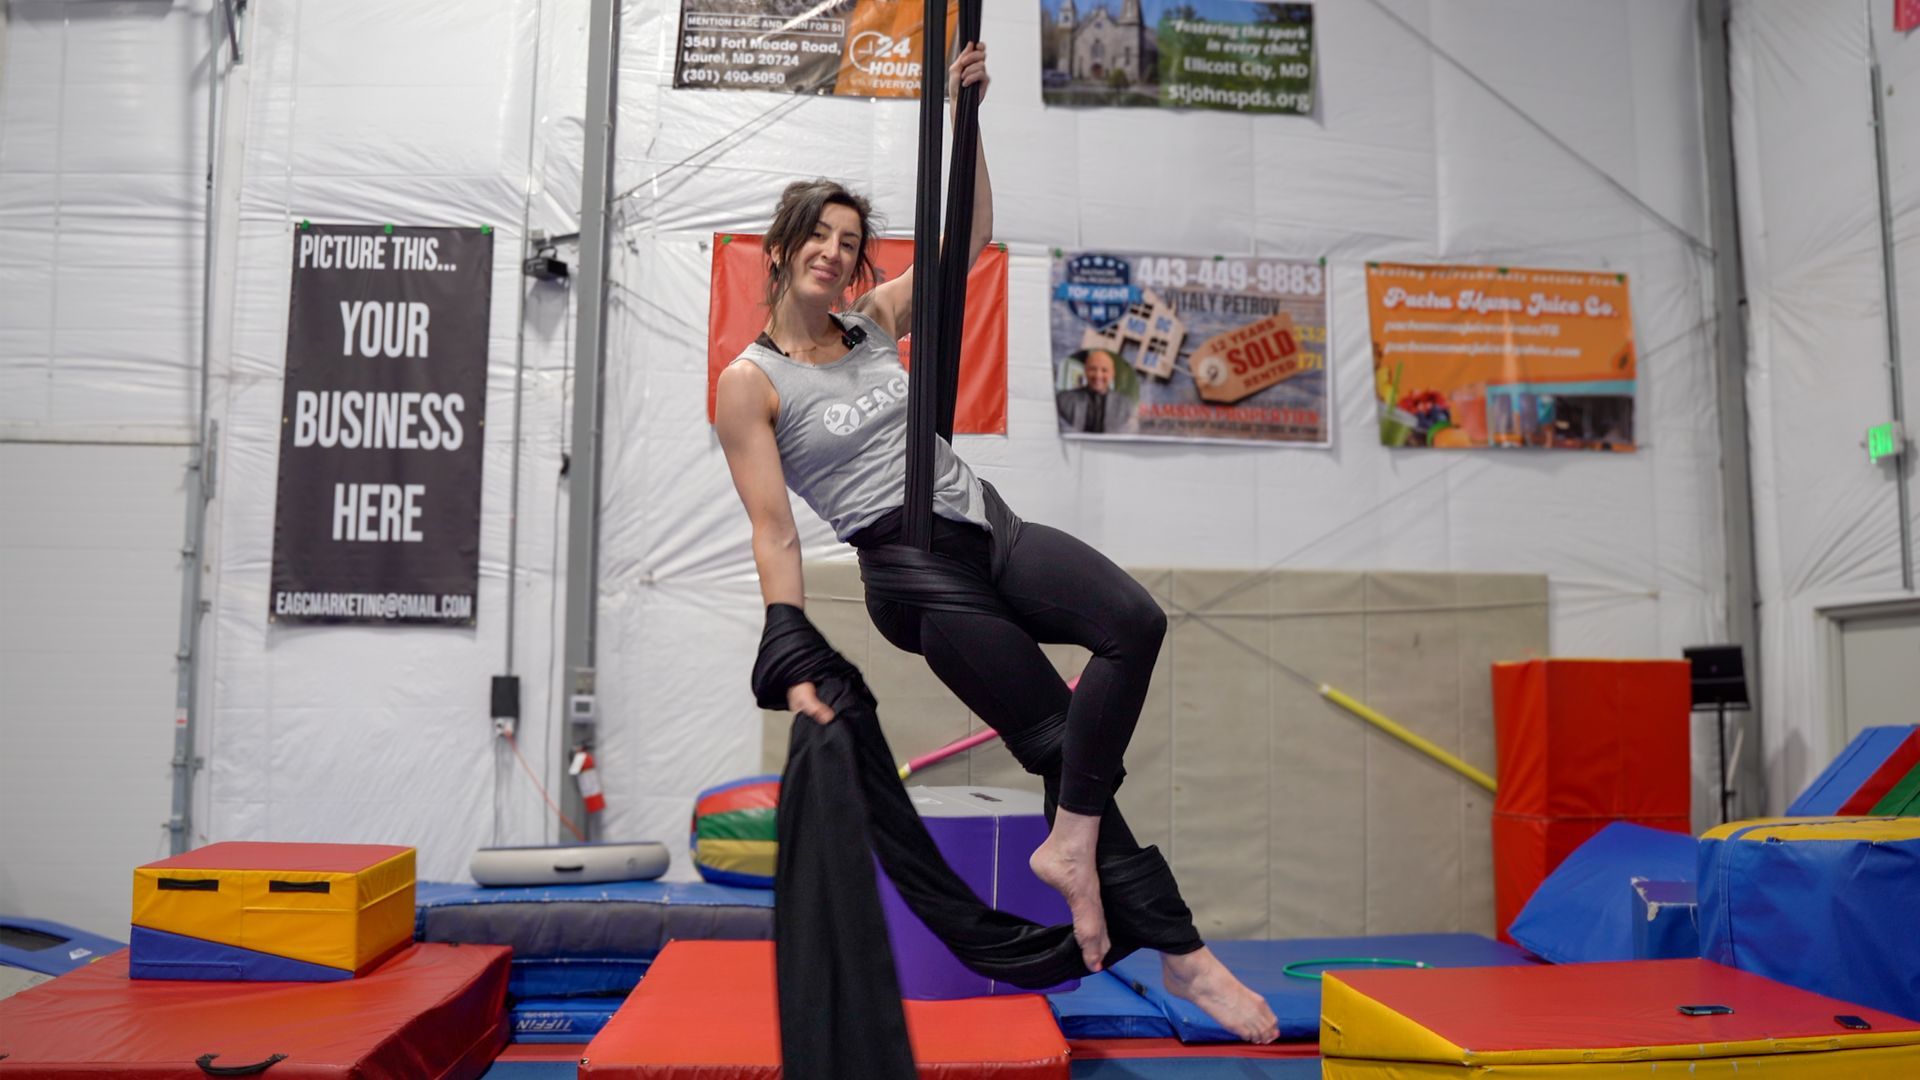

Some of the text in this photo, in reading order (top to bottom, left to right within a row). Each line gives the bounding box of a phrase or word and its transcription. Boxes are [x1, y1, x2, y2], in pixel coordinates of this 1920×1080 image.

[688, 16, 731, 26] MENTION
[762, 20, 784, 29] AND
[810, 22, 829, 31] FOR
[1242, 26, 1265, 39] the
[1267, 26, 1307, 42] spark
[683, 51, 799, 66] Laurel, MD 20724
[684, 36, 842, 56] 3541 Fort Meade Road,
[874, 35, 911, 58] 24
[1206, 38, 1221, 52] in
[1223, 43, 1260, 57] every
[682, 69, 786, 84] (301) 490-5050
[869, 61, 922, 77] HOUR
[1183, 56, 1309, 80] Ellicott City, MD
[871, 80, 921, 89] EVERYDA
[1168, 83, 1310, 113] stjohnspds.org
[299, 234, 457, 272] PICTURE THIS...
[1137, 256, 1322, 296] 443-449-9883
[1165, 290, 1282, 316] VITALY PETROV
[1526, 292, 1581, 317] Juice
[340, 300, 430, 358] YOUR
[1226, 329, 1297, 375] SOLD
[855, 377, 909, 417] EAG
[293, 390, 465, 451] BUSINESS
[332, 482, 426, 543] HERE
[275, 591, 472, 618] EAGCMARKETING@GMAIL.COM
